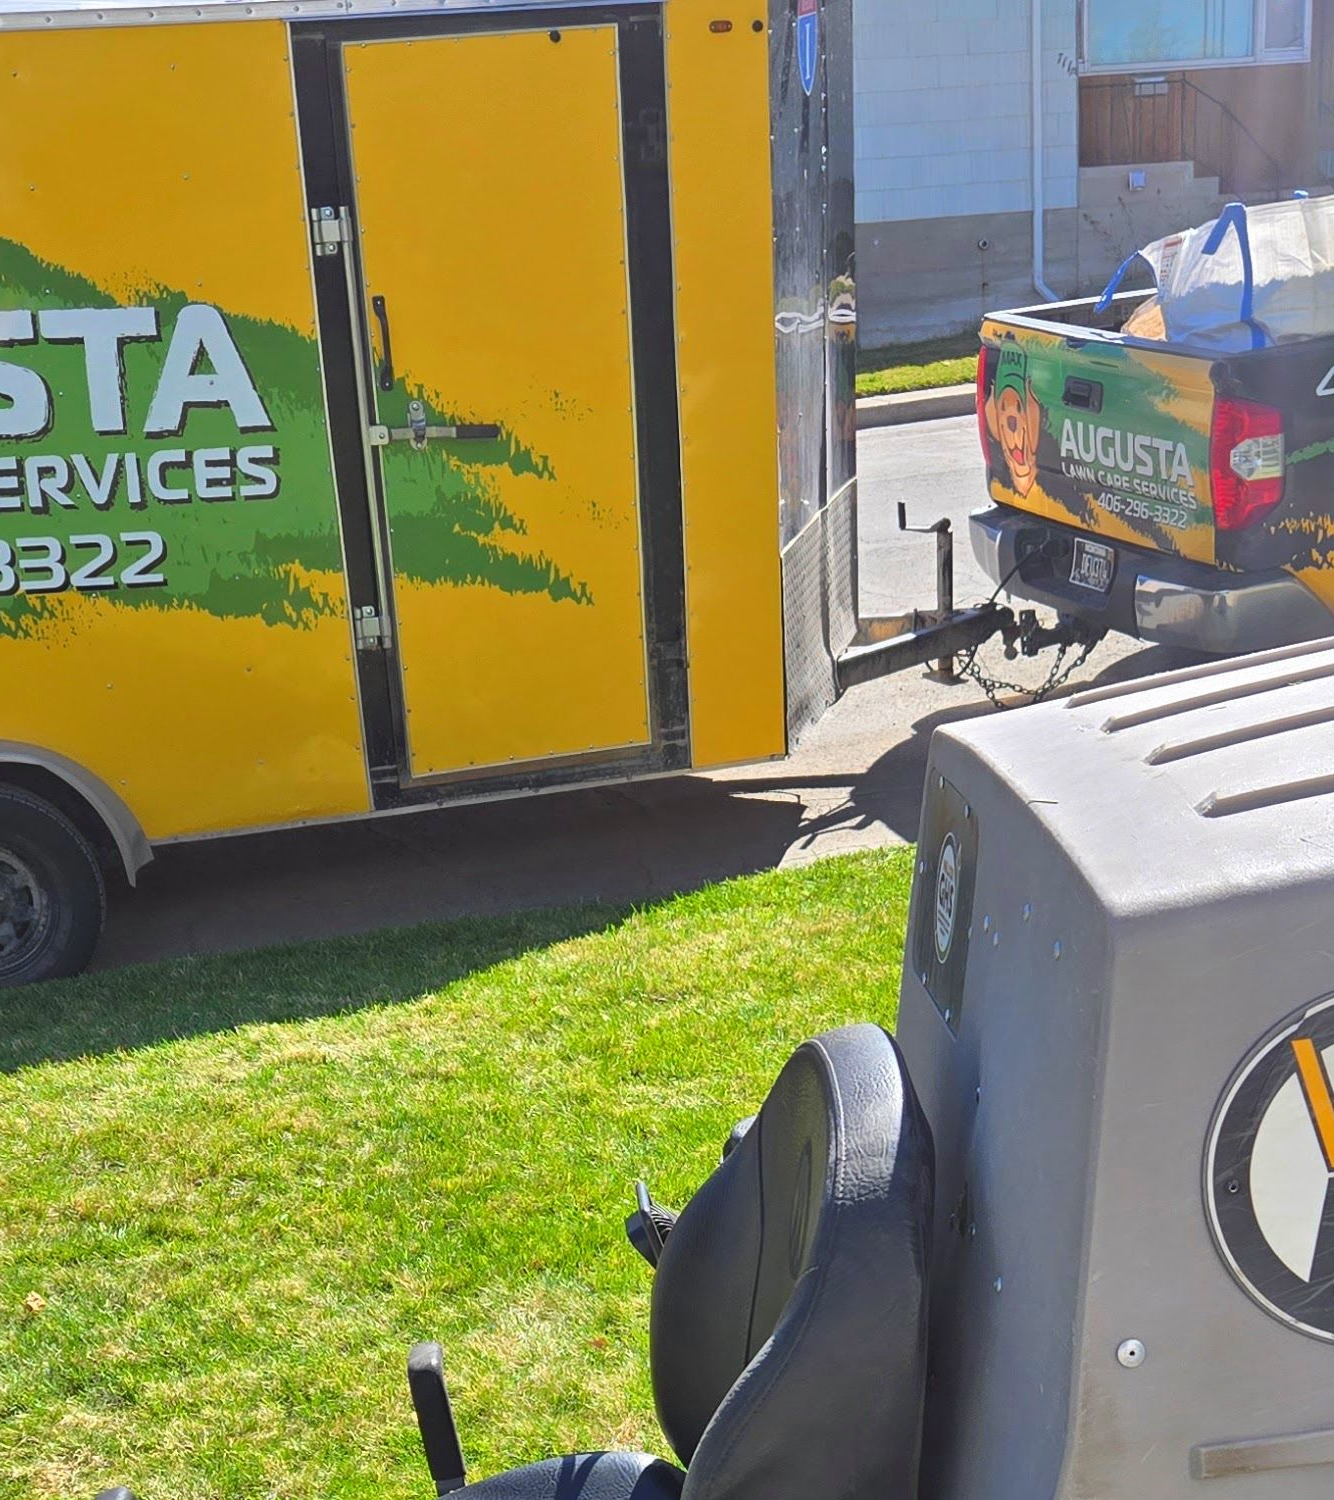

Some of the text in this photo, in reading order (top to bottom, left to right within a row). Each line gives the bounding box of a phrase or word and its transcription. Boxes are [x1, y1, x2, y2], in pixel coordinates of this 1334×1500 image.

[1001, 349, 1023, 369] MAX
[1060, 418, 1195, 488] AUGUSTA
[1061, 461, 1198, 511] LAWN CARE SERVICES
[1097, 491, 1188, 529] 406-296-3322
